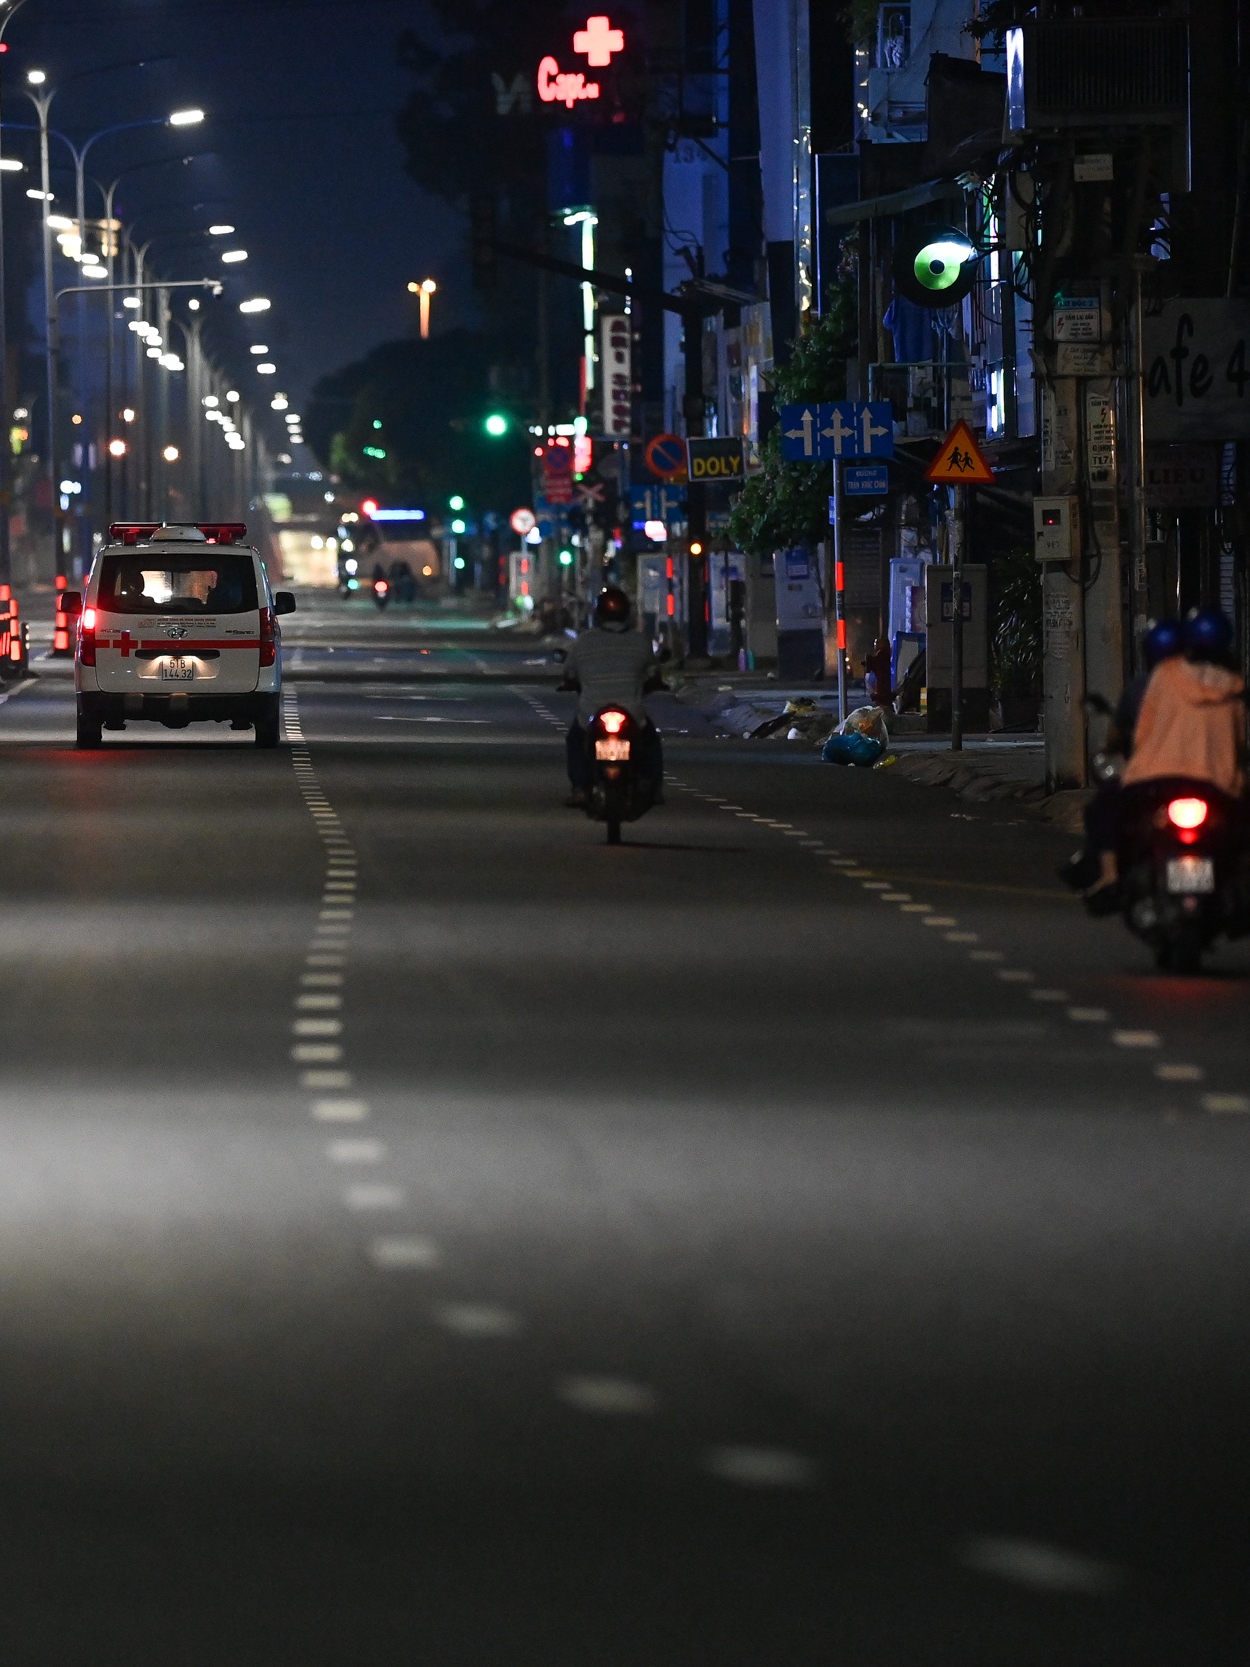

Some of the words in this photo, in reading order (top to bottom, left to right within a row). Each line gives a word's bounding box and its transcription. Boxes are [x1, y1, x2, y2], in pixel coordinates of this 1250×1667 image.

[1149, 313, 1214, 407] afe
[693, 456, 741, 477] DOLY
[169, 660, 186, 669] 51B
